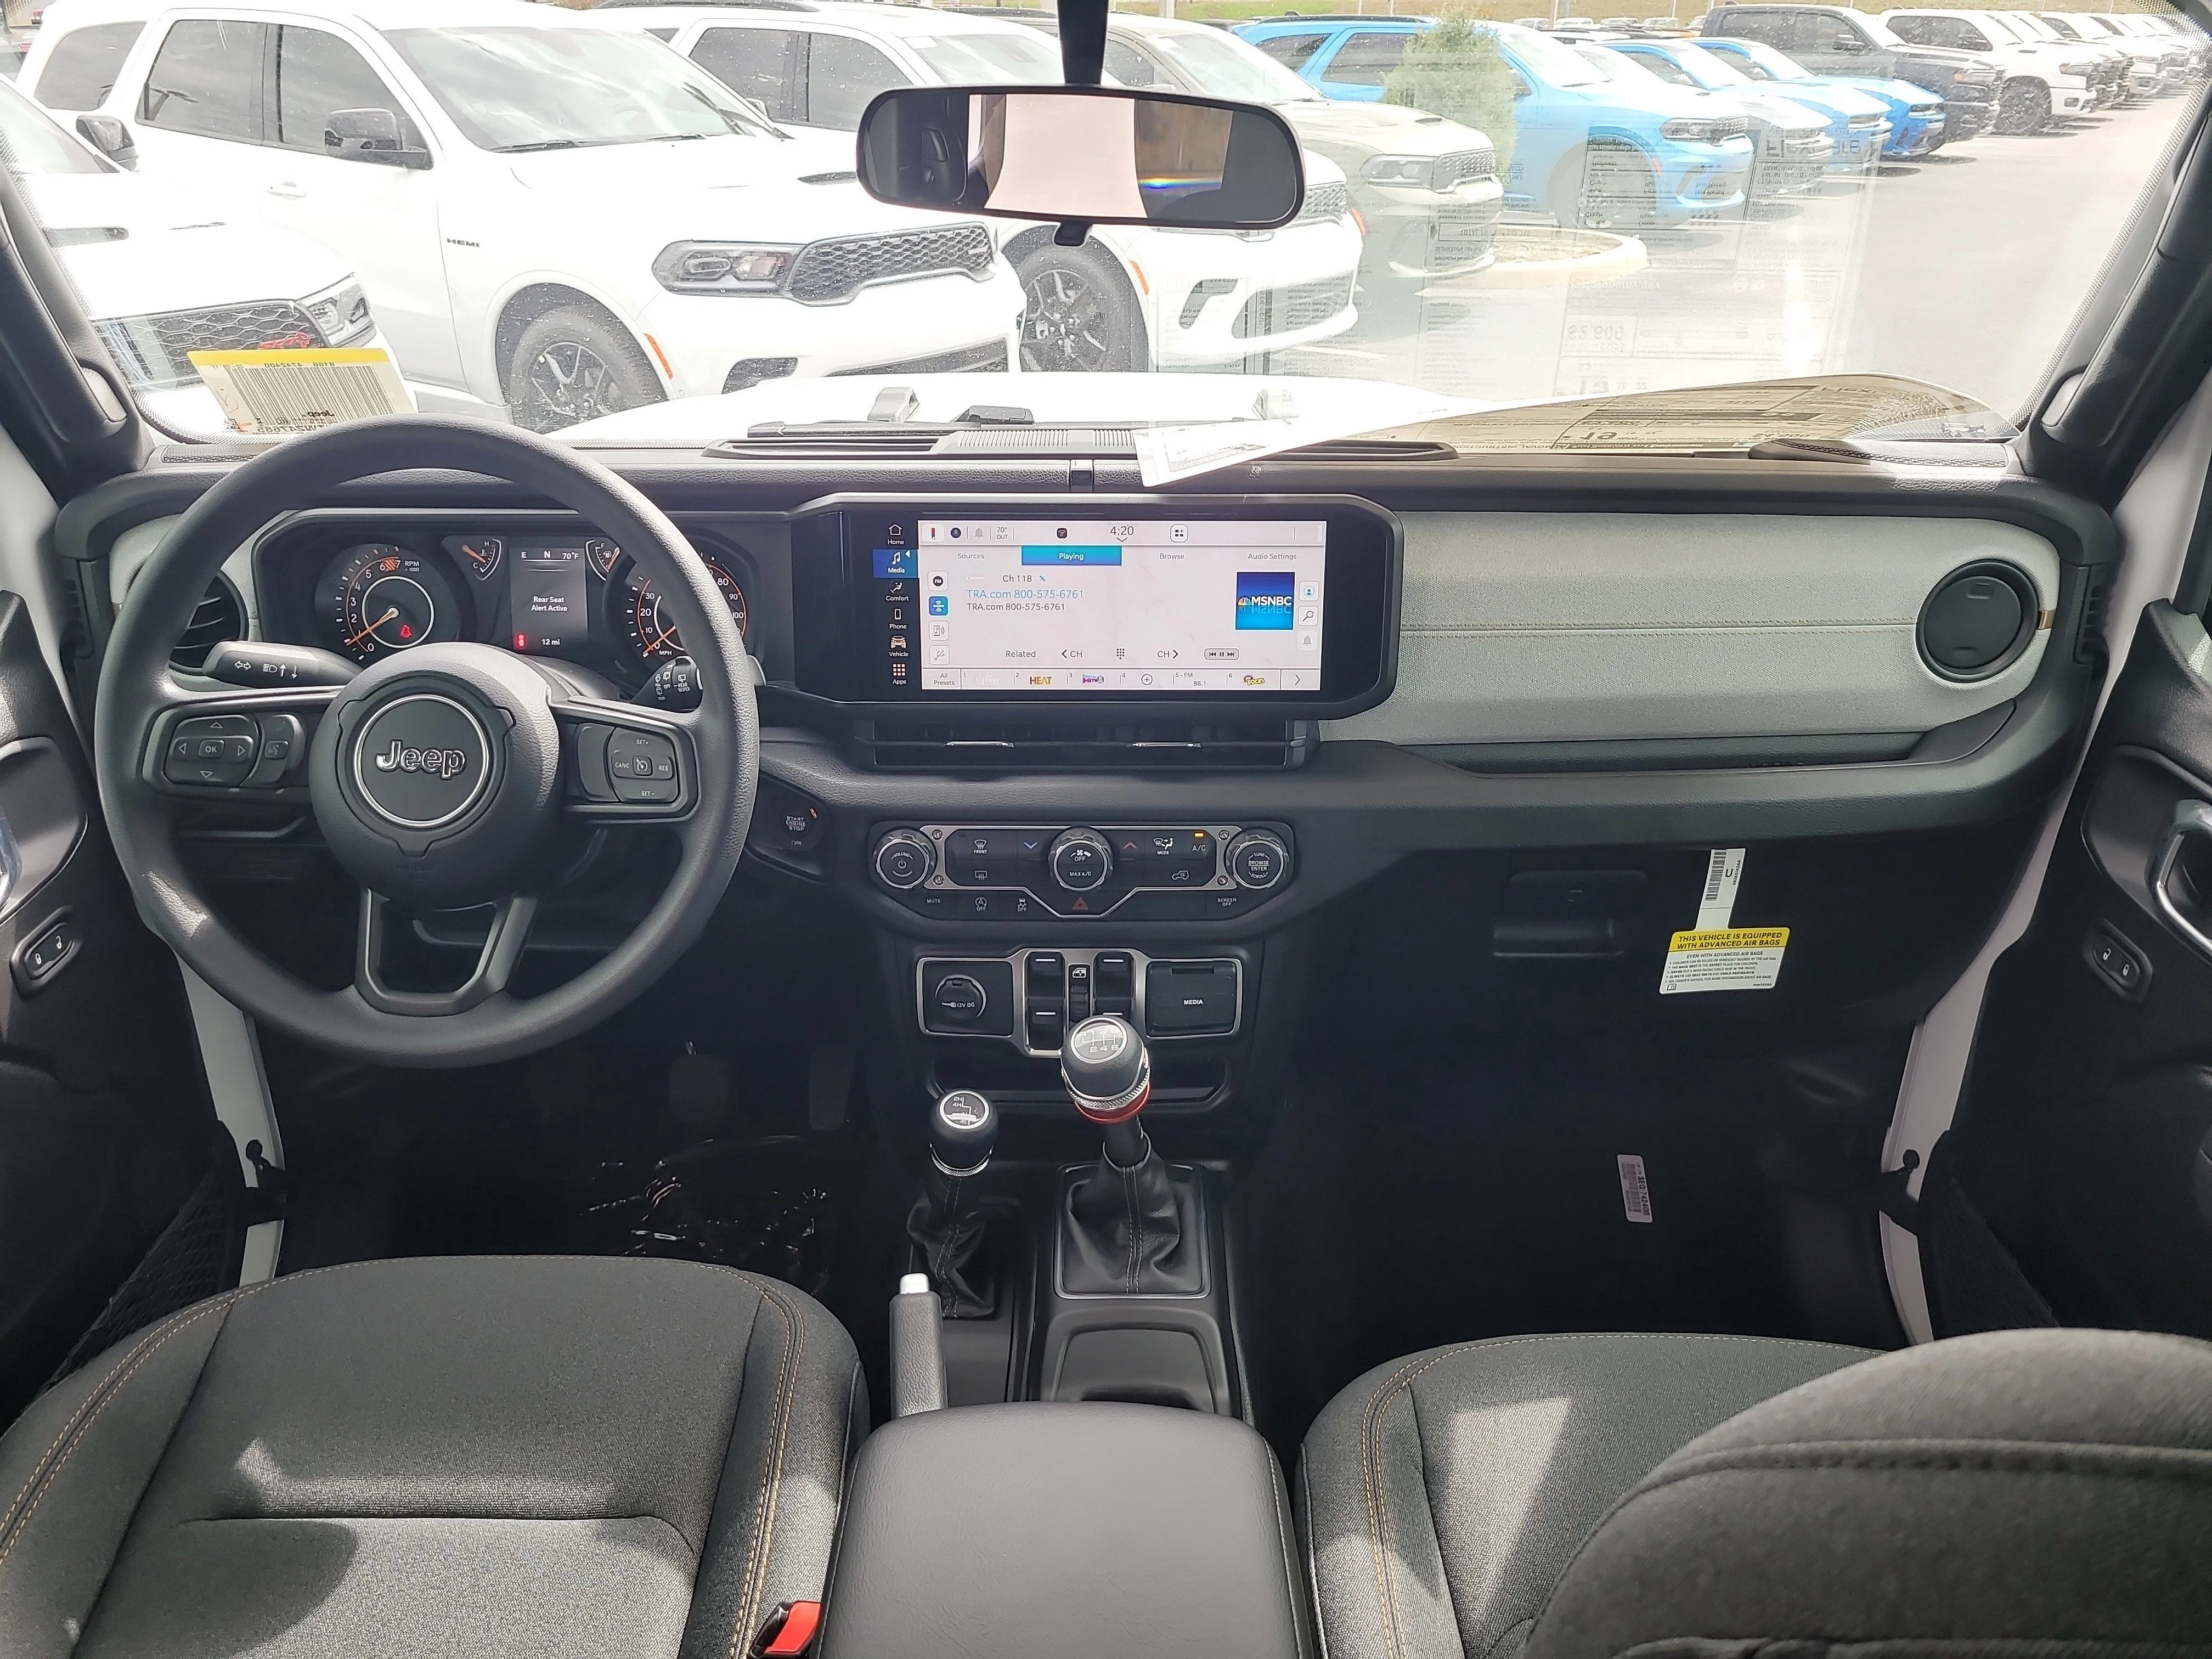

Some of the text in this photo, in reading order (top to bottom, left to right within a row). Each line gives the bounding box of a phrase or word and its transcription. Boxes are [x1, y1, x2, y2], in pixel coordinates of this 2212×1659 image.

[447, 238, 479, 247] HEMI
[1110, 526, 1135, 536] 4:20
[1059, 552, 1084, 561] Playing
[1269, 552, 1297, 561] Settings
[379, 563, 386, 571] 6
[395, 560, 402, 569] 7
[365, 569, 372, 579] 5
[354, 582, 362, 591] 4
[717, 578, 729, 586] 80
[645, 592, 655, 600] 30
[729, 592, 738, 601] 90
[967, 590, 1084, 599] TRA.com 800-575-6761
[350, 597, 357, 607] 3
[1251, 596, 1293, 606] MSNBC
[967, 603, 1065, 611] TRA.com 800-575-6761
[640, 608, 652, 617] 20
[732, 611, 744, 619] 100
[351, 614, 358, 623] 2
[645, 626, 653, 634] 10
[368, 642, 375, 651] 0
[1029, 676, 1052, 685] HEAT
[205, 745, 218, 753] OK
[376, 740, 466, 780] Jeep
[1725, 868, 1734, 878] U
